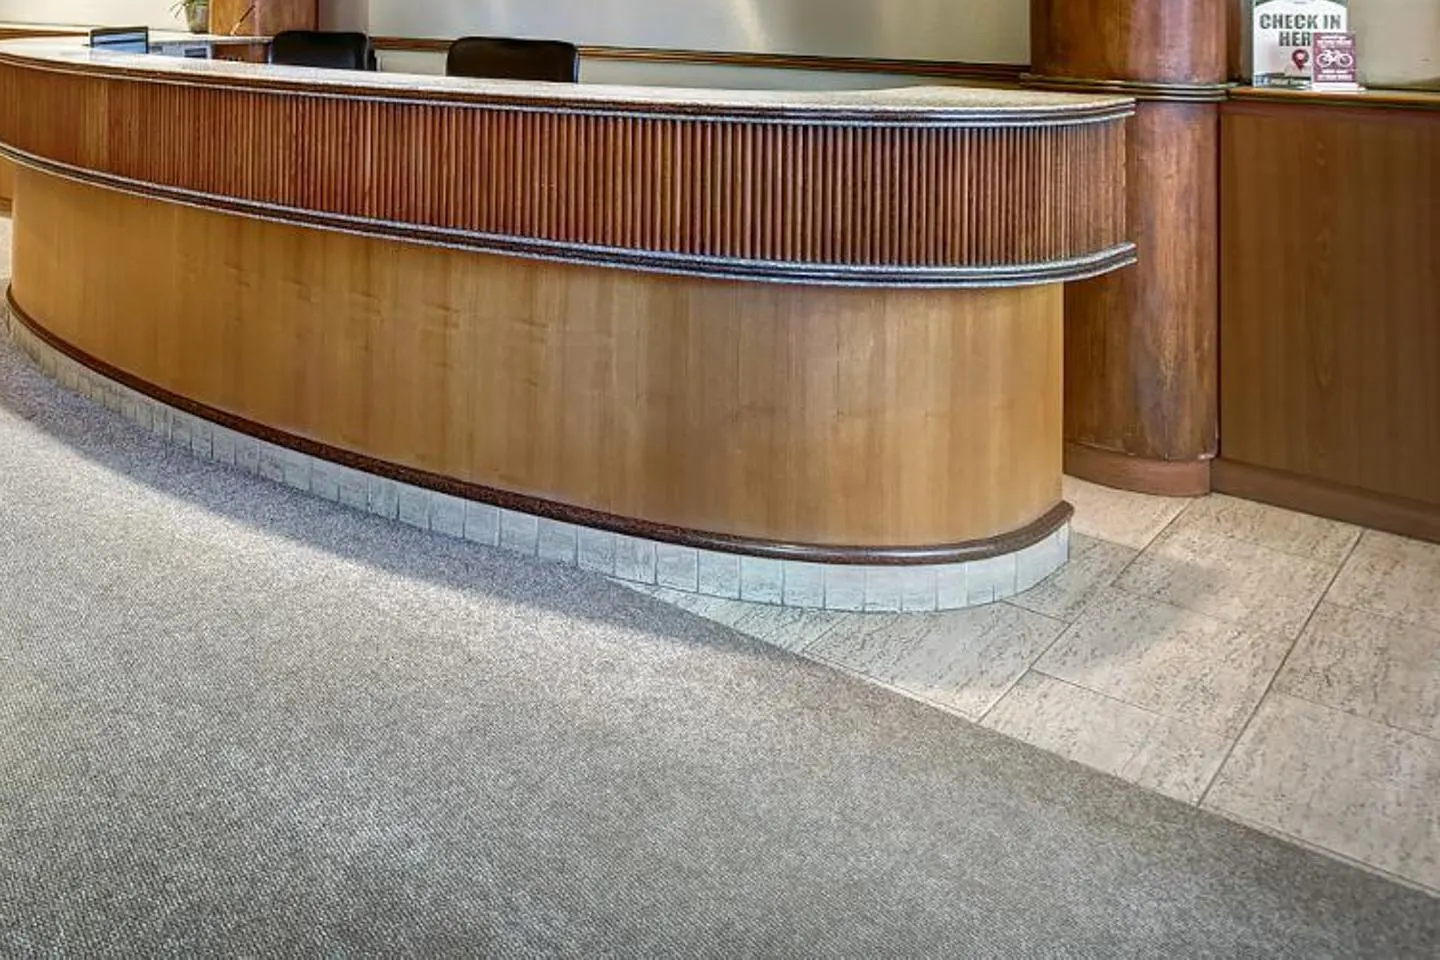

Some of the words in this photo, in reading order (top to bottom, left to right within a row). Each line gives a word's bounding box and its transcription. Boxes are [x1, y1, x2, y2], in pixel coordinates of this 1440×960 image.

[1260, 13, 1318, 29] CHECK
[1323, 14, 1341, 29] IN
[1279, 31, 1311, 47] HER
